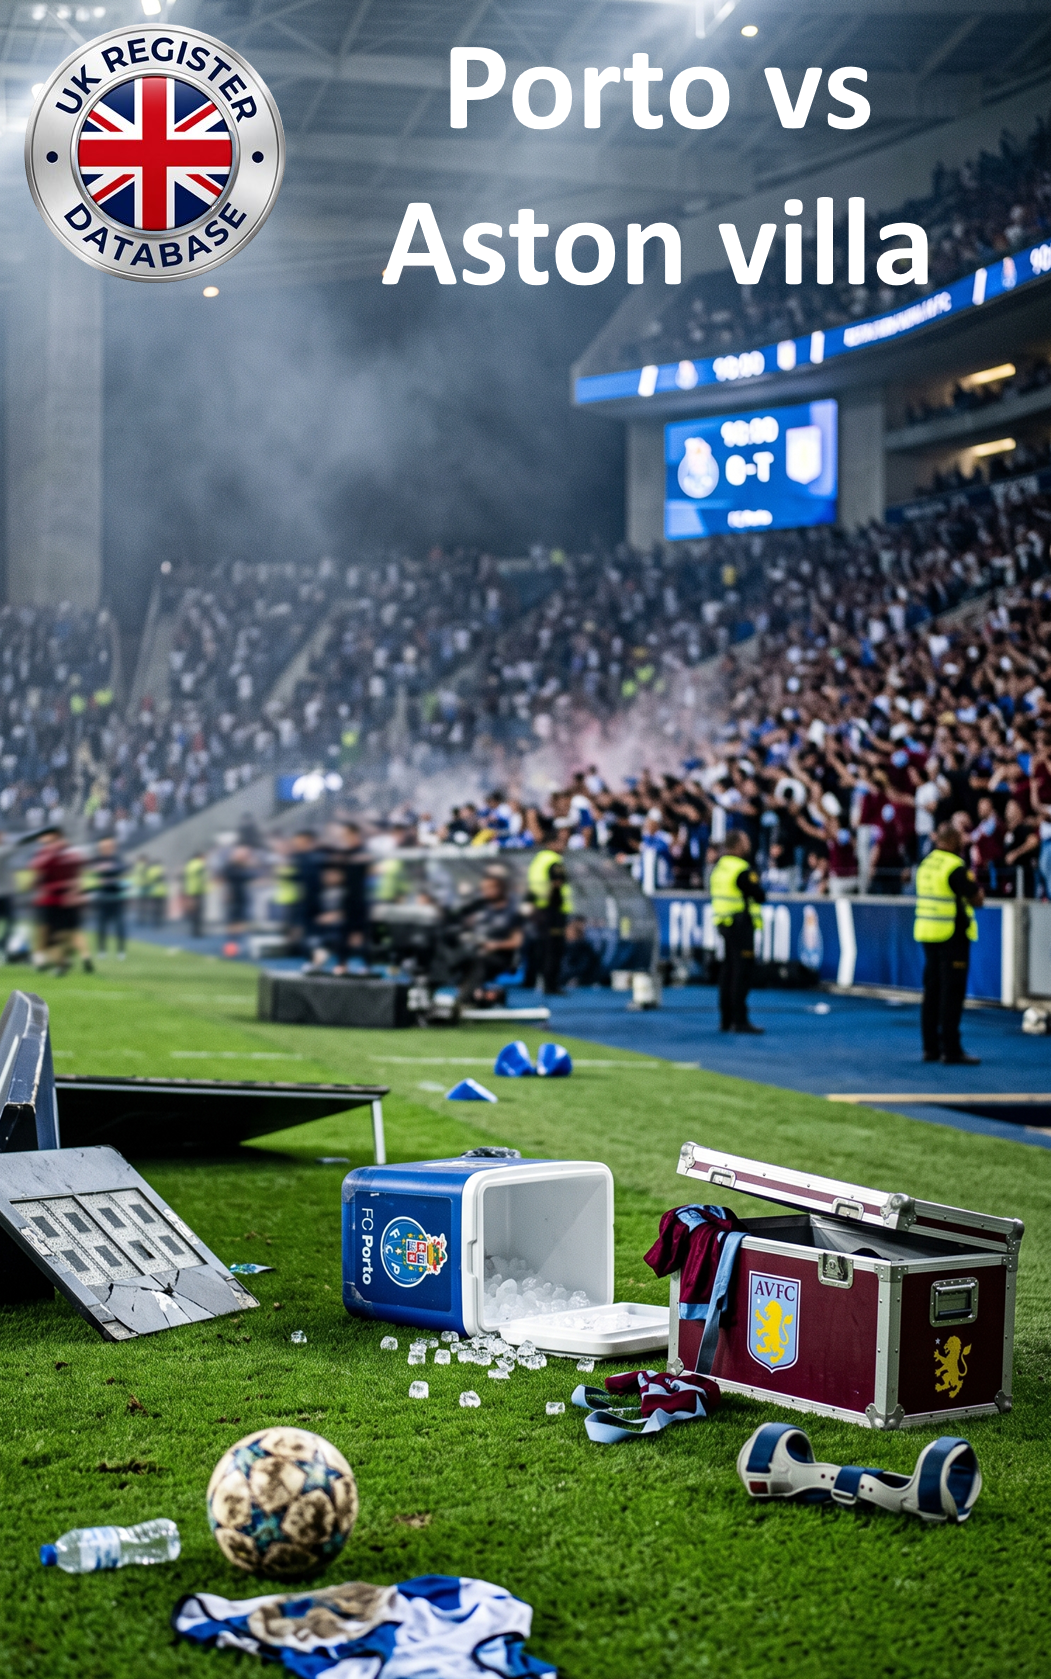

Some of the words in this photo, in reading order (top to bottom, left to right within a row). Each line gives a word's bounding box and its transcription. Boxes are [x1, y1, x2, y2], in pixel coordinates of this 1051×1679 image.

[361, 1207, 374, 1231] FC
[361, 1234, 374, 1285] Porto
[754, 1280, 796, 1302] AVFC
